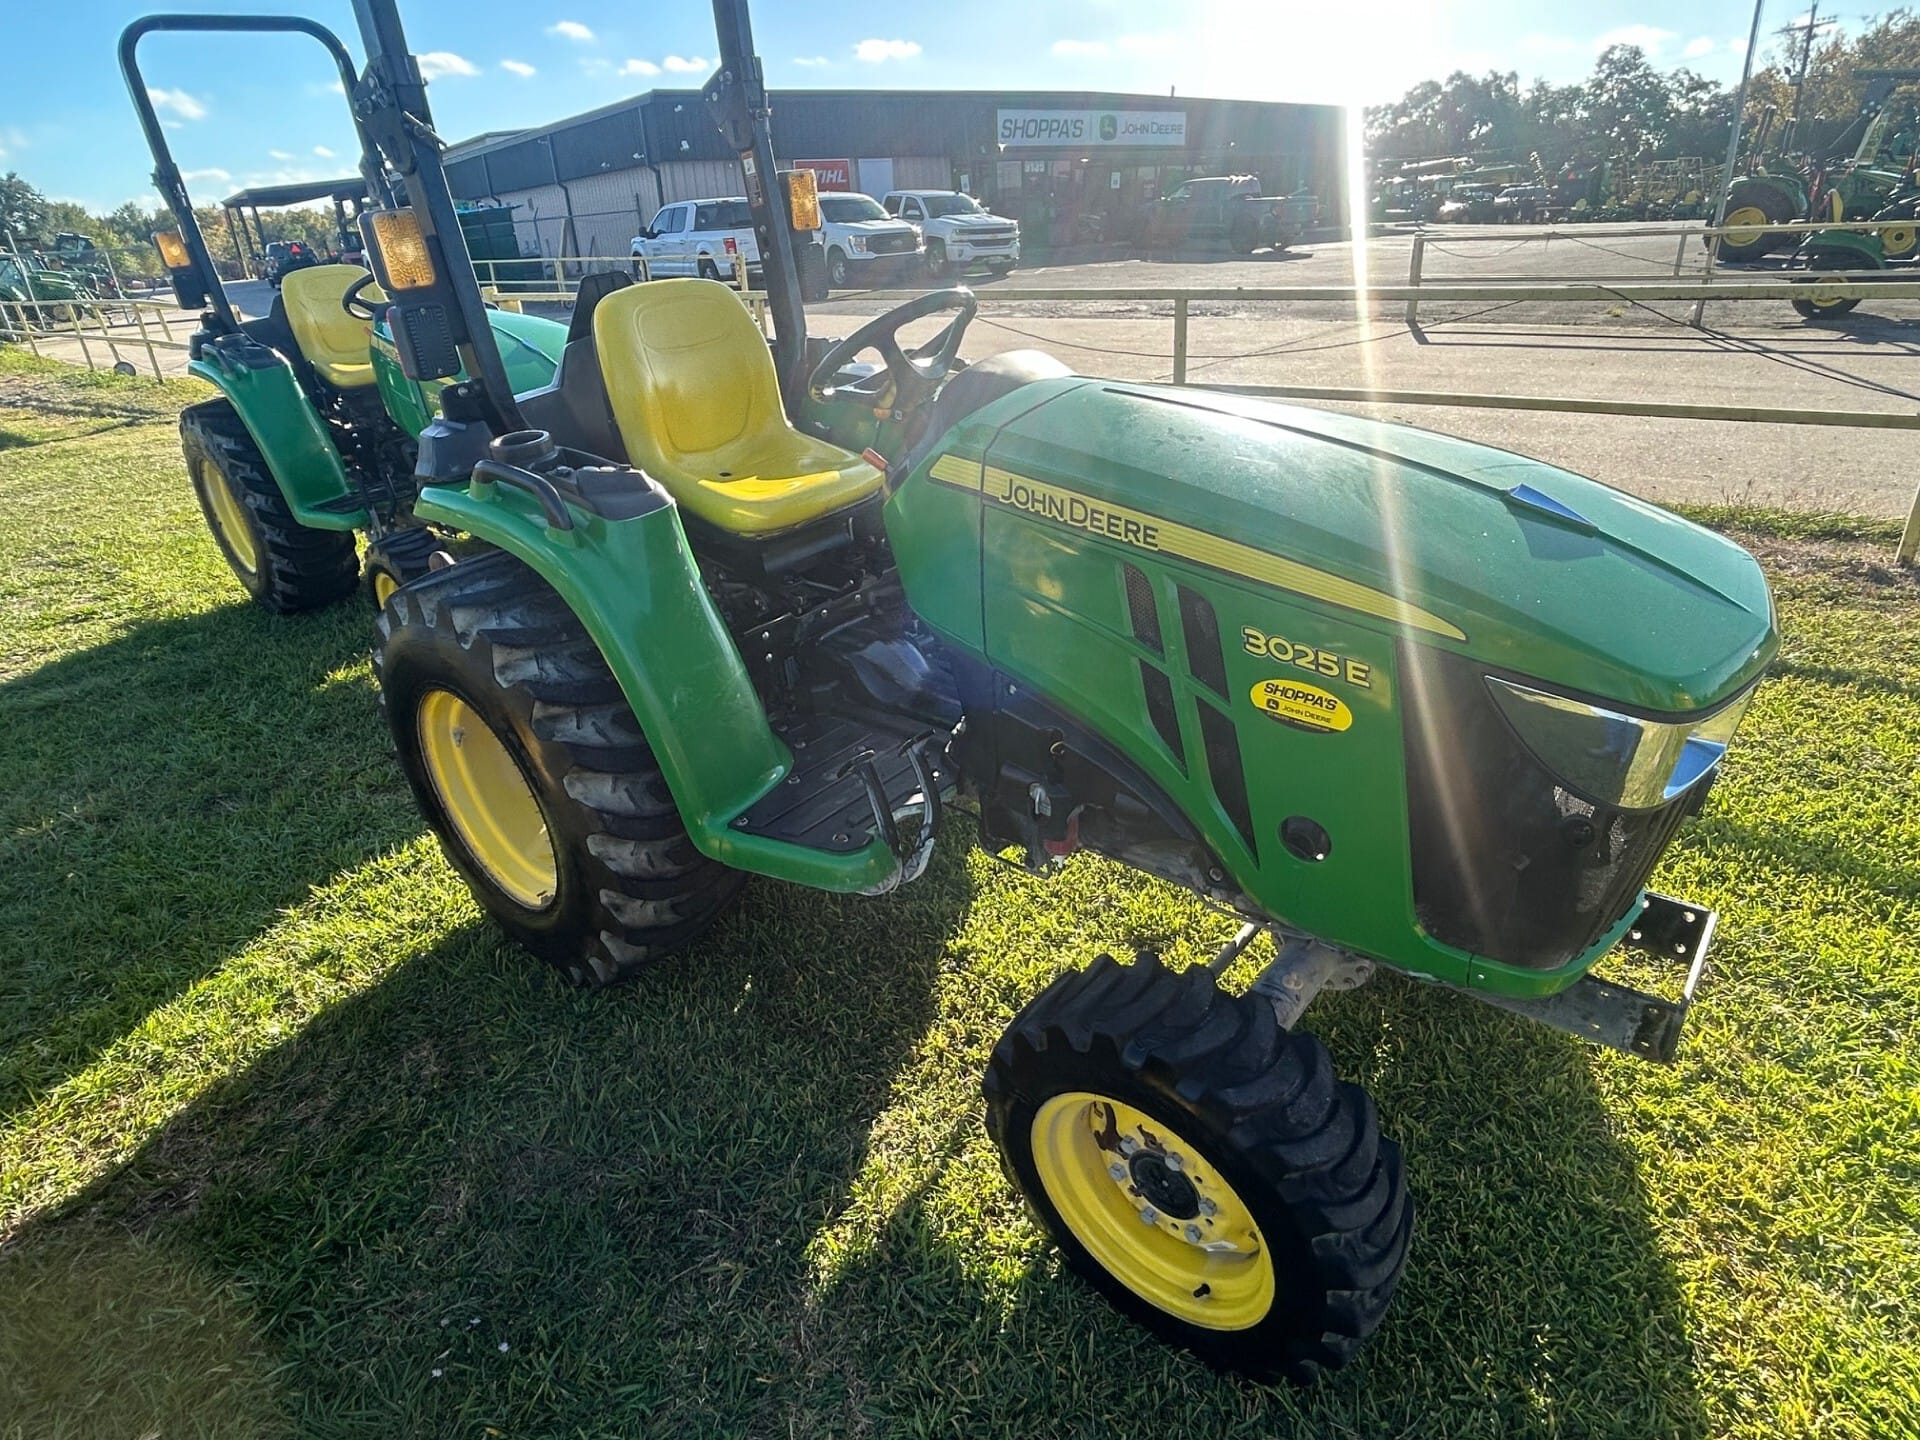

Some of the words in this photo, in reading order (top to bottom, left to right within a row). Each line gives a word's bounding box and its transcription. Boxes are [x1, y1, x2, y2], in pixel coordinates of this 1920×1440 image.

[1001, 118, 1084, 139] SHOPPA'S
[1121, 118, 1149, 135] JOHN
[1150, 121, 1184, 135] DEERE
[815, 169, 847, 185] TIHL
[1001, 478, 1064, 519] JOHN
[1069, 497, 1159, 549] DEERE
[1264, 682, 1338, 711] SHOPPA'S
[1281, 705, 1303, 716] JOHN
[1304, 711, 1332, 724] DEERE
